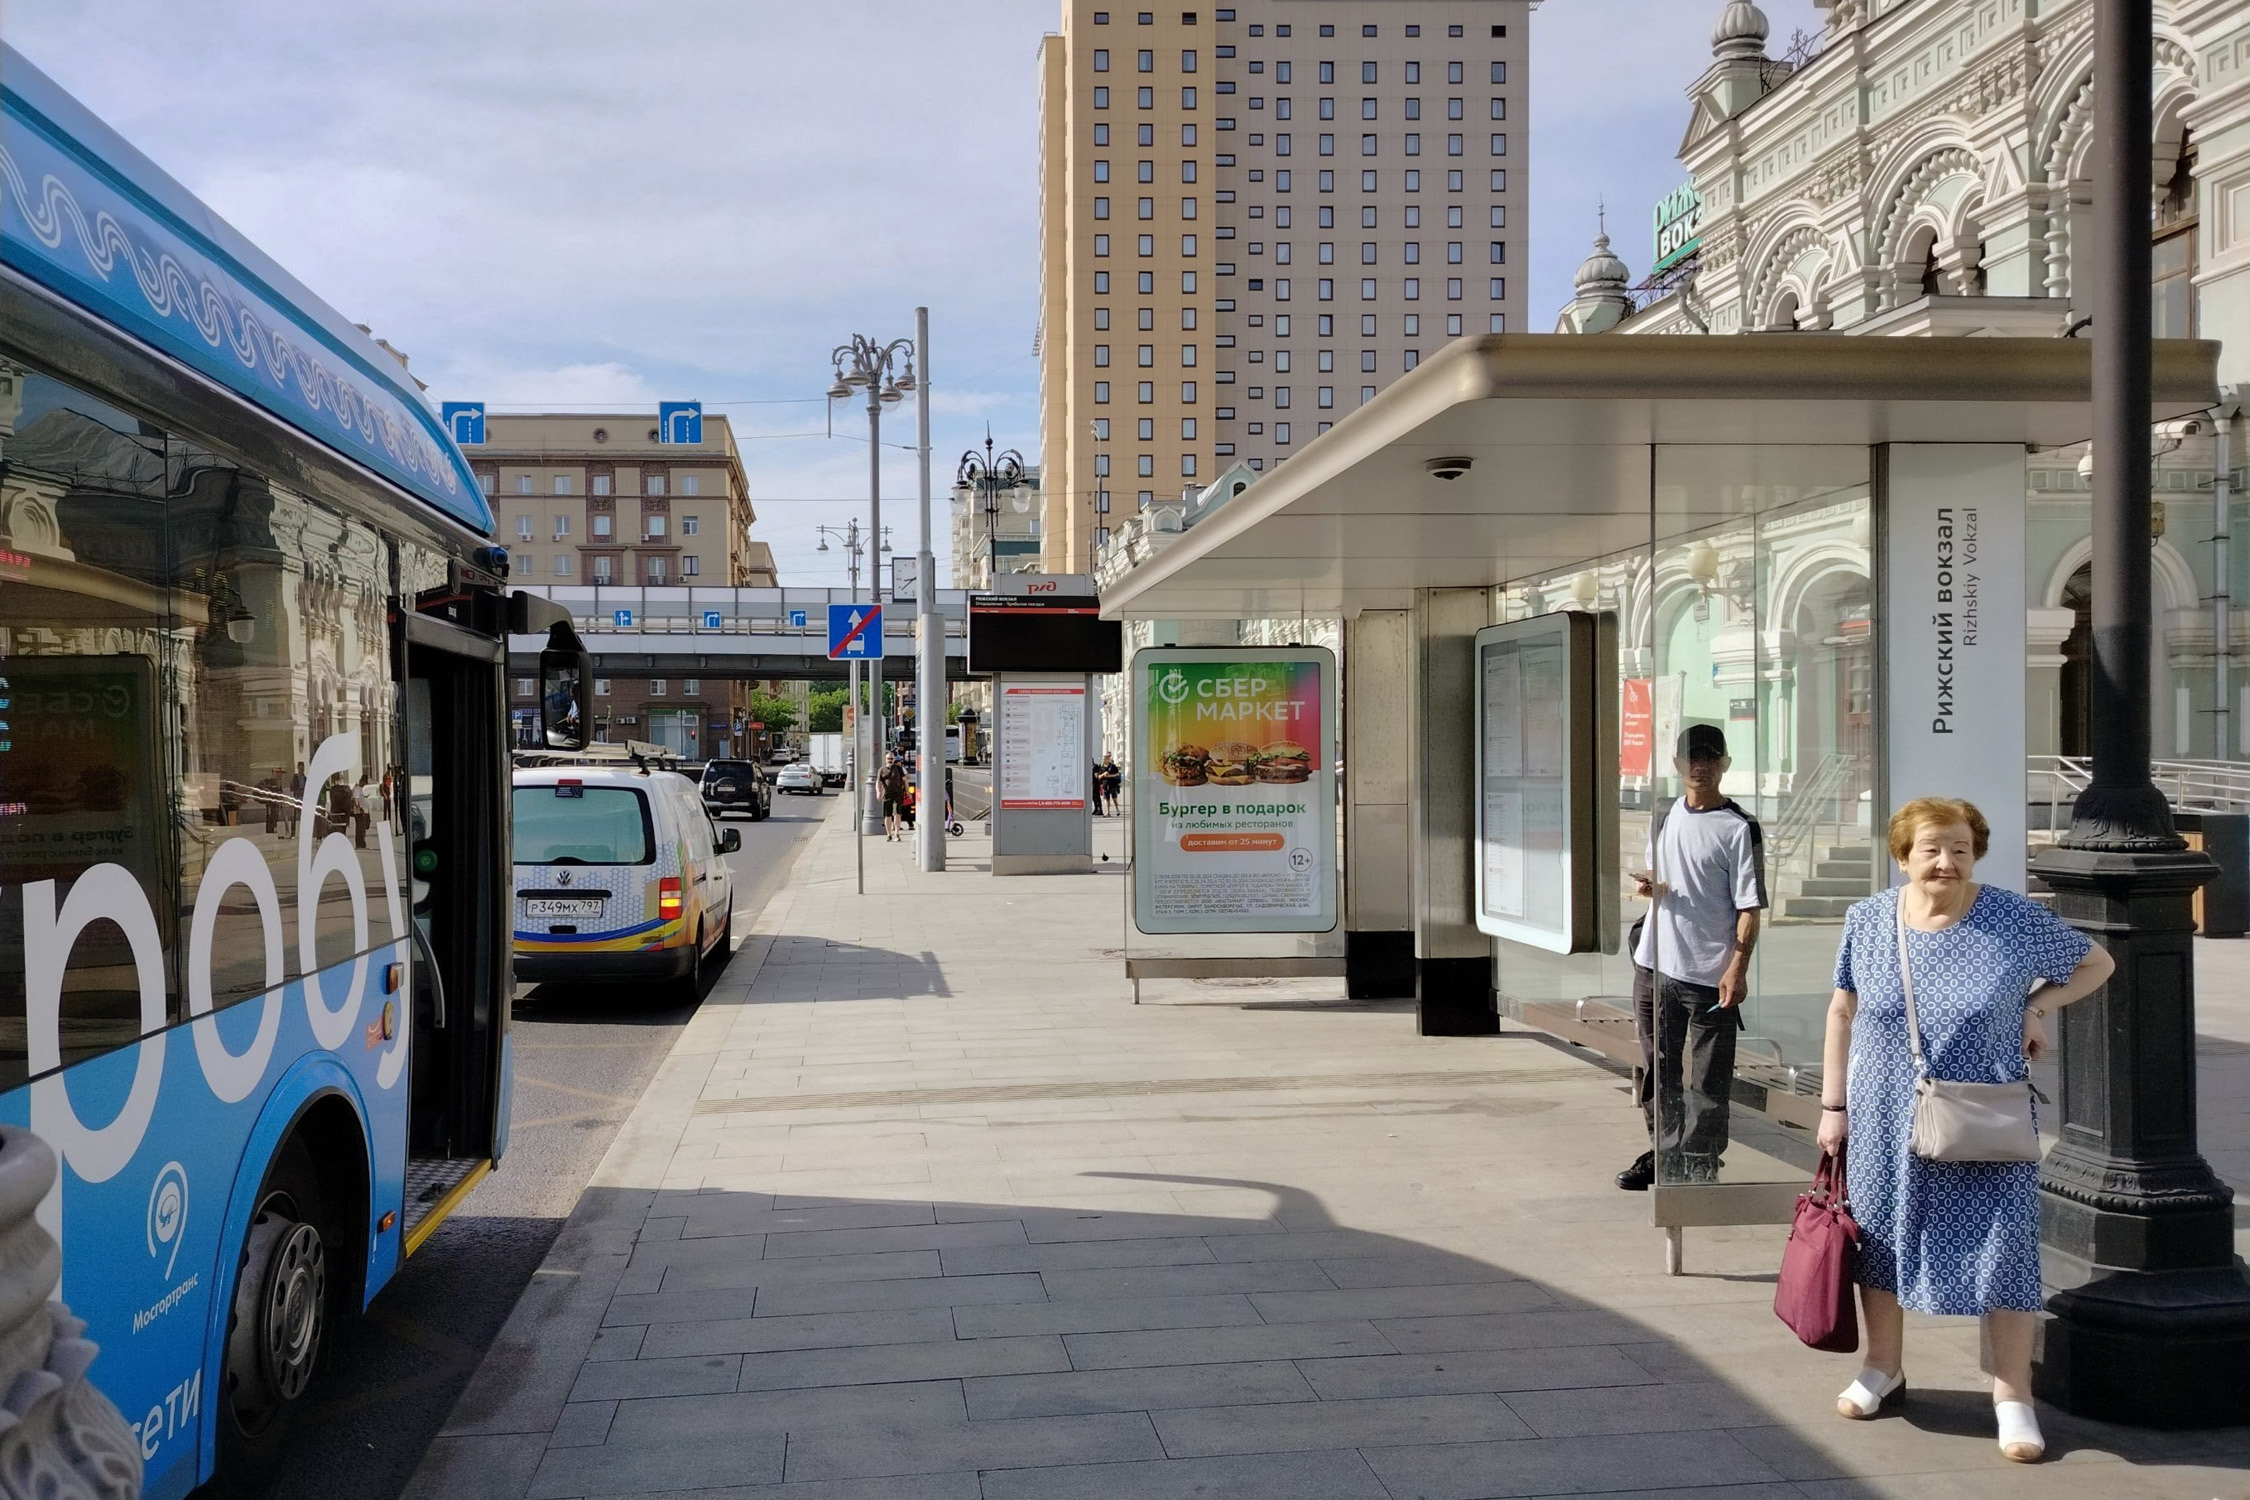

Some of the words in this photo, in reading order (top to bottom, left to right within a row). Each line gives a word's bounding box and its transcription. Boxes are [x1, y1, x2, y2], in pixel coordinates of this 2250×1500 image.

[1962, 507, 1978, 566] Vokzal
[1937, 508, 1954, 603] вокзал
[1962, 573, 1981, 646] Rizhskiy
[1932, 613, 1954, 734] Рижский
[1197, 678, 1267, 698] СБЕР
[1196, 701, 1306, 721] МАРКЕТ
[1159, 802, 1217, 818] Бургер
[1222, 804, 1231, 815] в
[1235, 803, 1307, 818] подарок
[1171, 821, 1183, 829] из
[1185, 820, 1232, 829] любимых
[1235, 820, 1294, 830] ресторанов
[1188, 838, 1227, 847] доставим
[1228, 838, 1238, 846] от
[1239, 837, 1250, 846] 25
[1251, 838, 1278, 846] минут
[1291, 854, 1311, 866] 12+
[580, 900, 600, 911] 797
[133, 1272, 199, 1335] Мосгортранс
